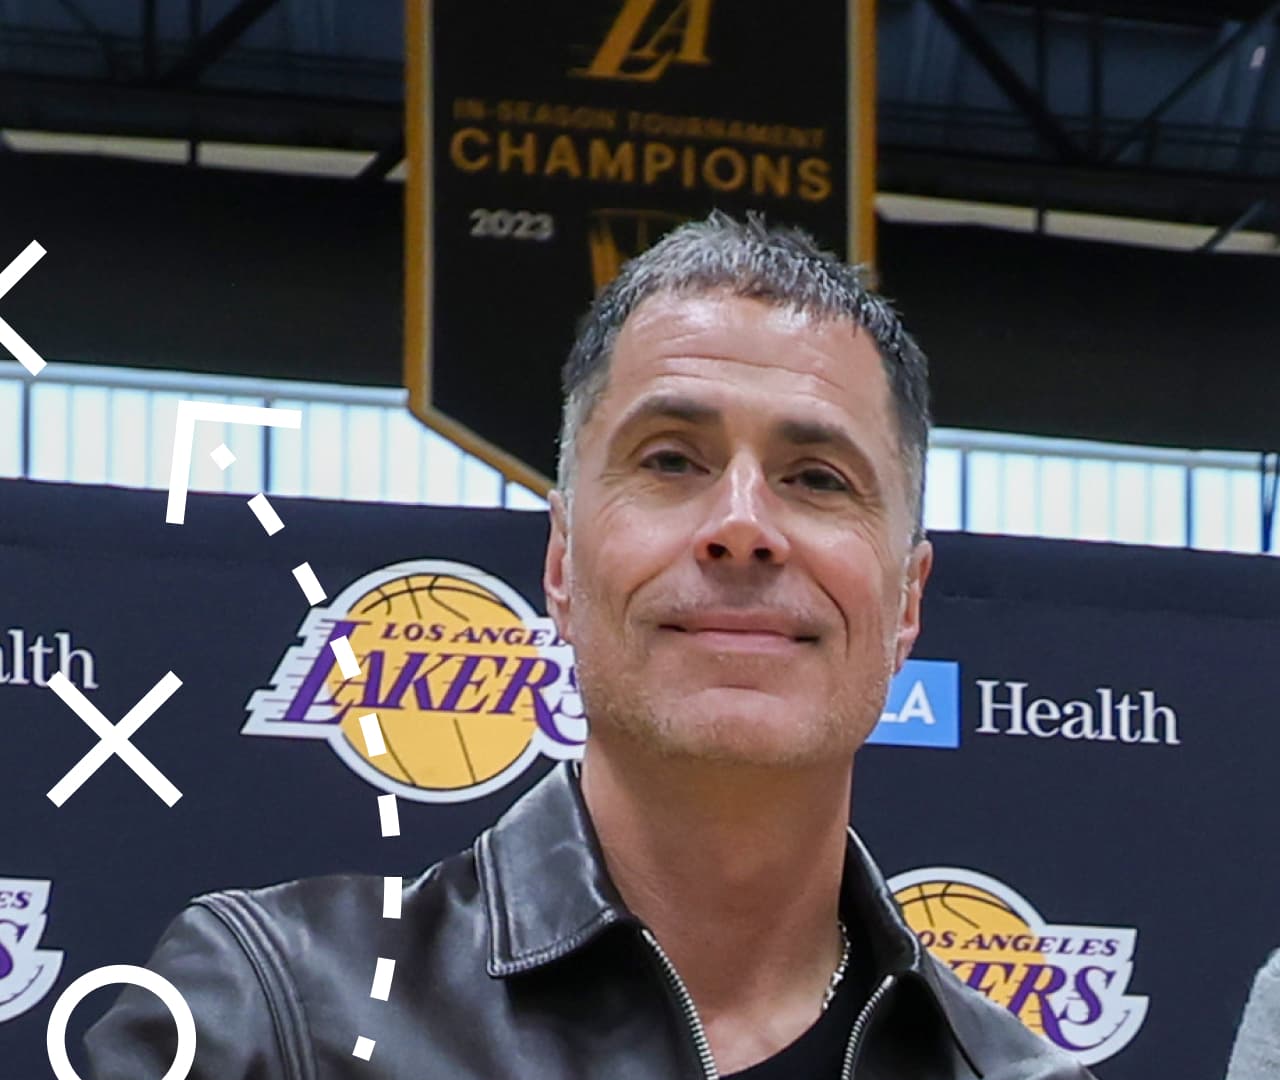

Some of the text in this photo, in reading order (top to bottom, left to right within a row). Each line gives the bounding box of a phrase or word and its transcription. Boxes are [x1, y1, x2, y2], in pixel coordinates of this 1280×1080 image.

[628, 110, 827, 149] TOURNAMENT
[449, 127, 832, 202] CHAMPIONS
[469, 208, 555, 241] 2023
[381, 622, 567, 647] LOS ANGEL
[975, 679, 1181, 745] Health
[914, 930, 1121, 957] OS ANGELES
[947, 959, 1131, 1052] ERS
